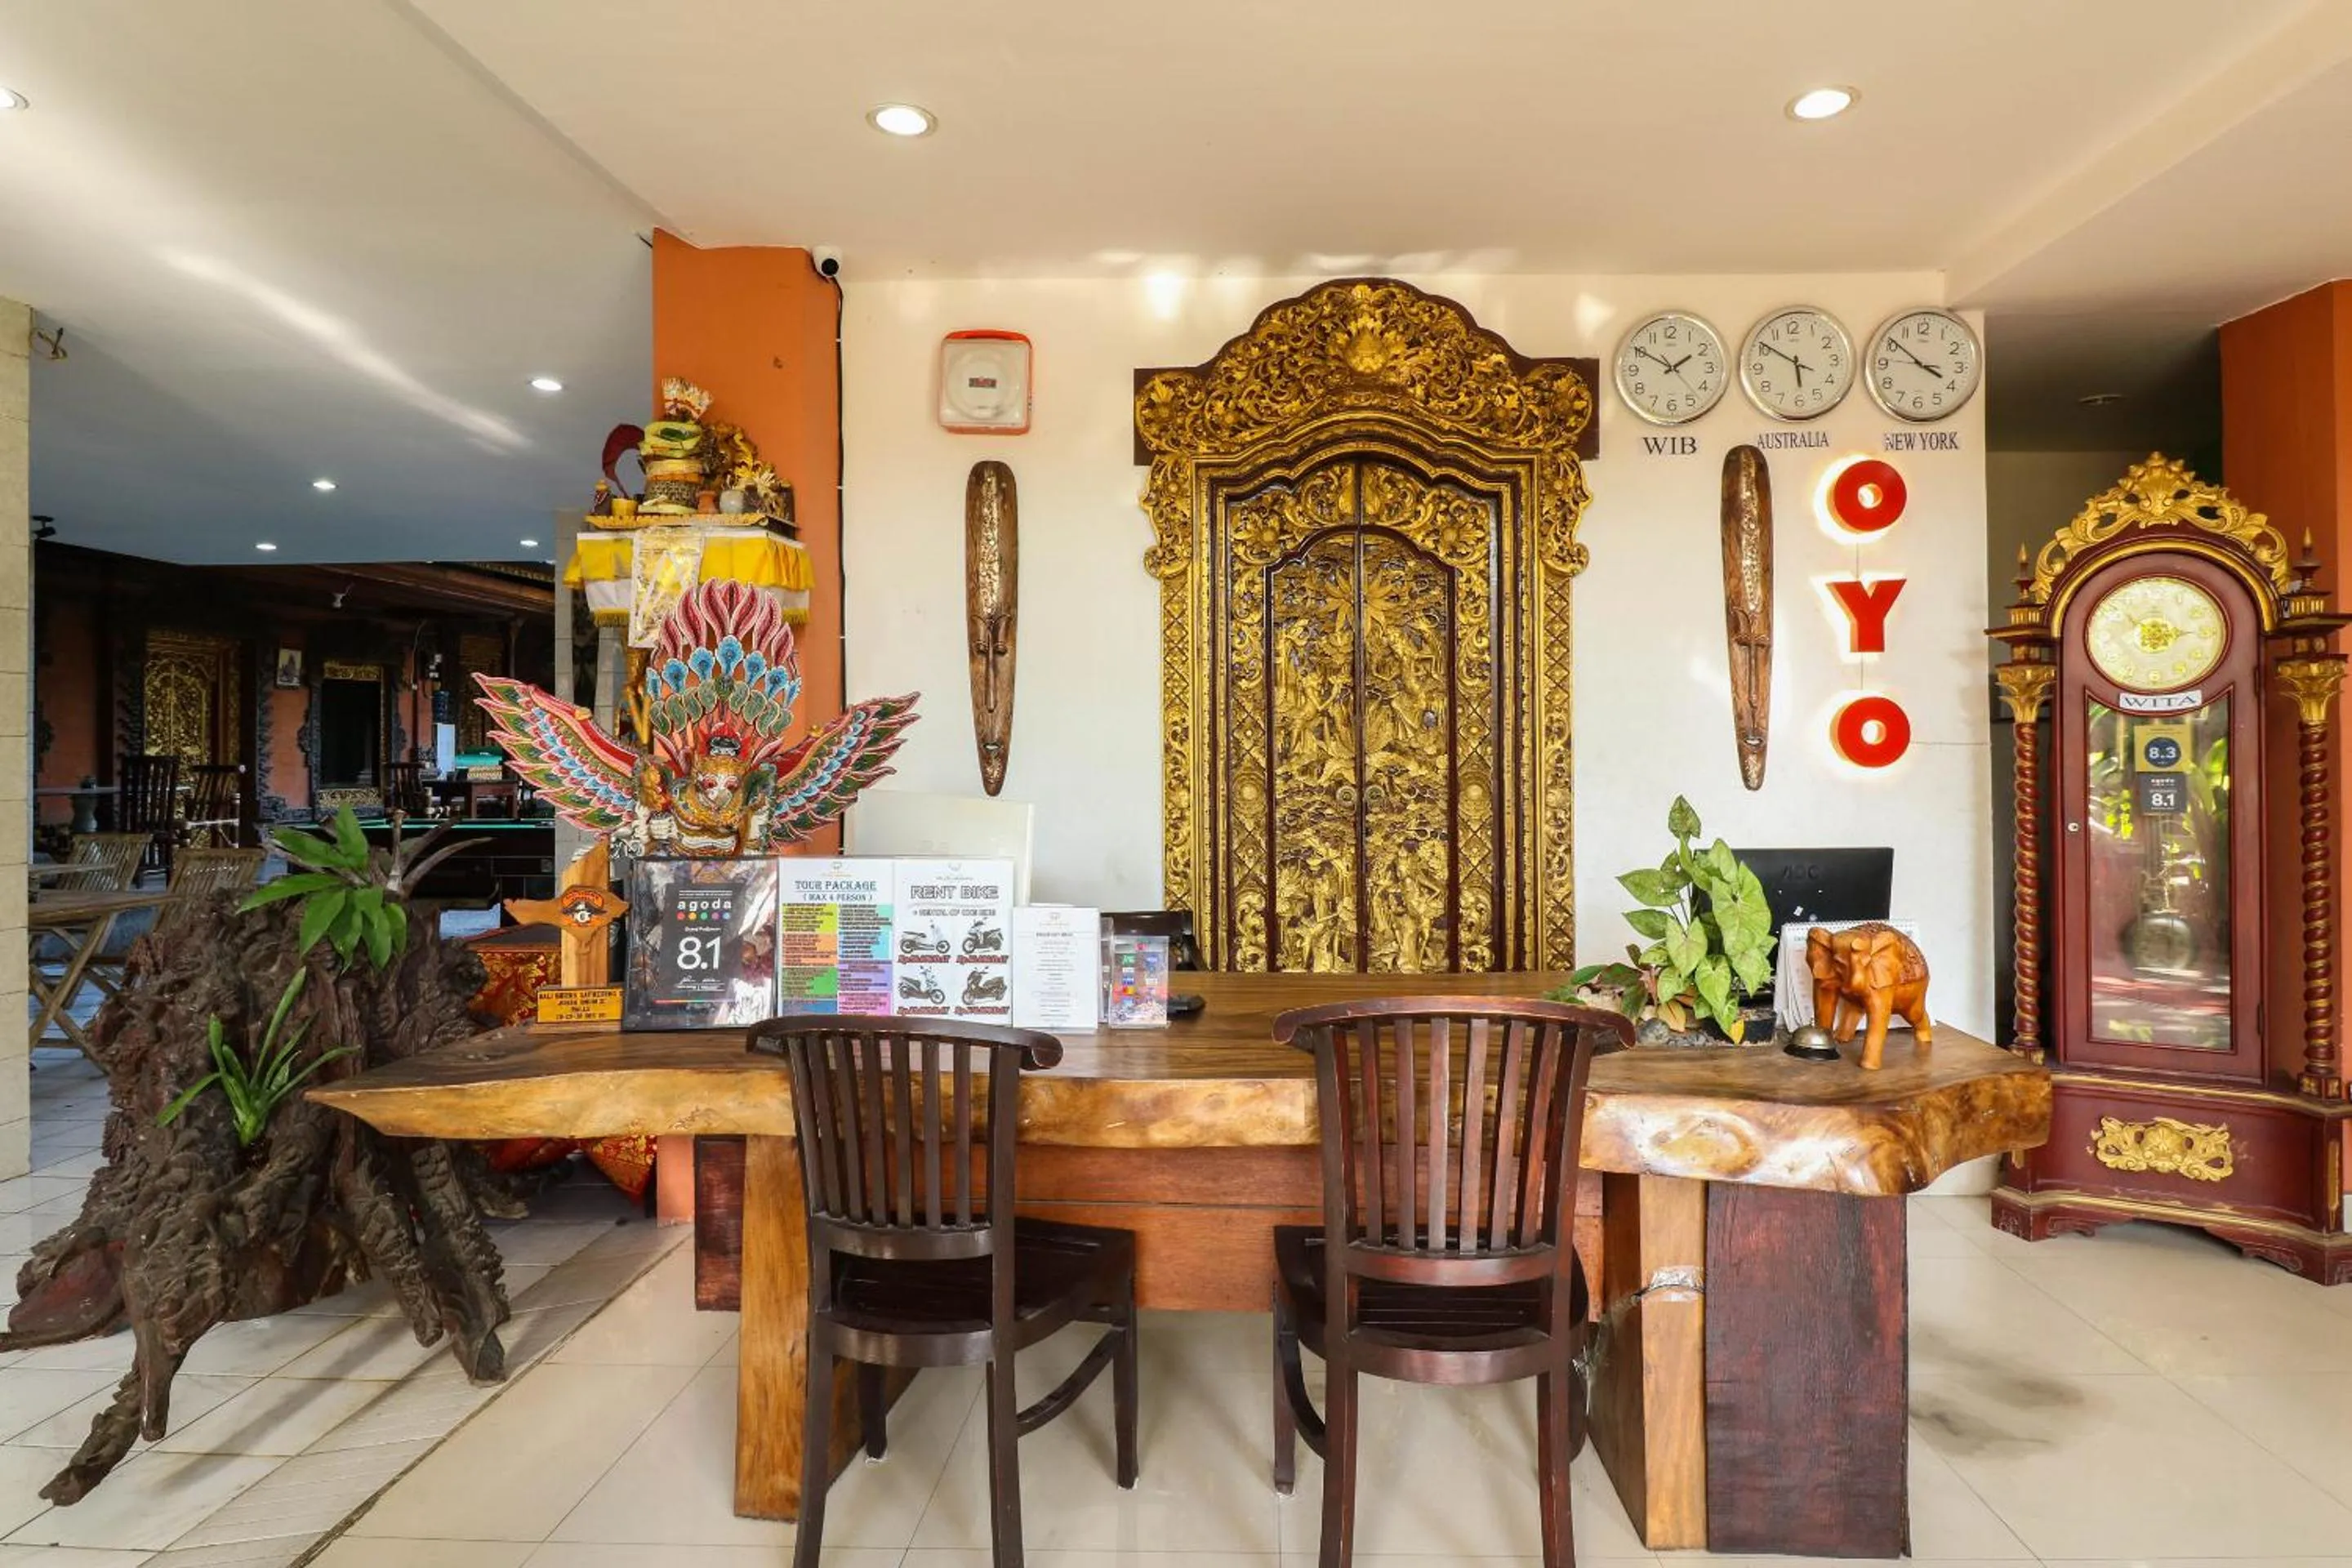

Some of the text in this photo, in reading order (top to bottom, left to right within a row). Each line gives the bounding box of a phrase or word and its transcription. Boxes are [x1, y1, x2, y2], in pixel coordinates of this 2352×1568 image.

[1665, 327, 1677, 339] 12
[1787, 321, 1798, 335] 12
[1918, 323, 1929, 336] 12
[1821, 336, 1832, 350] 2
[1949, 341, 1959, 354] 2
[1698, 344, 1708, 356] 2
[1829, 354, 1838, 367] 3
[1878, 358, 1889, 370] 9
[1628, 365, 1639, 376] 9
[1704, 362, 1714, 373] 3
[1753, 363, 1763, 375] 9
[1954, 362, 1963, 373] 3
[1825, 373, 1834, 385] 4
[1882, 377, 1893, 389] 8
[1635, 382, 1645, 394] 8
[1698, 380, 1707, 391] 4
[1761, 381, 1771, 392] 8
[1947, 380, 1955, 392] 4
[1775, 393, 1784, 404] 7
[1812, 389, 1823, 400] 5
[1895, 391, 1905, 403] 7
[1932, 393, 1942, 405] 5
[1650, 395, 1658, 408] 7
[1667, 399, 1677, 411] 6
[1685, 395, 1695, 407] 5
[1795, 395, 1804, 408] 6
[1913, 397, 1922, 408] 6
[1642, 436, 1698, 455] WIB
[1757, 431, 1829, 449] AUSTRALIA
[1884, 431, 1958, 451] NEW YORK
[1824, 459, 1911, 768] OYO
[2125, 696, 2195, 707] WITA
[2149, 746, 2176, 759] 8.3
[2152, 793, 2175, 806] 8.1
[795, 880, 877, 890] TOUR PACKAGE
[911, 885, 999, 899] RENT BIKE
[677, 898, 732, 911] agoda
[677, 936, 720, 970] 8.1
